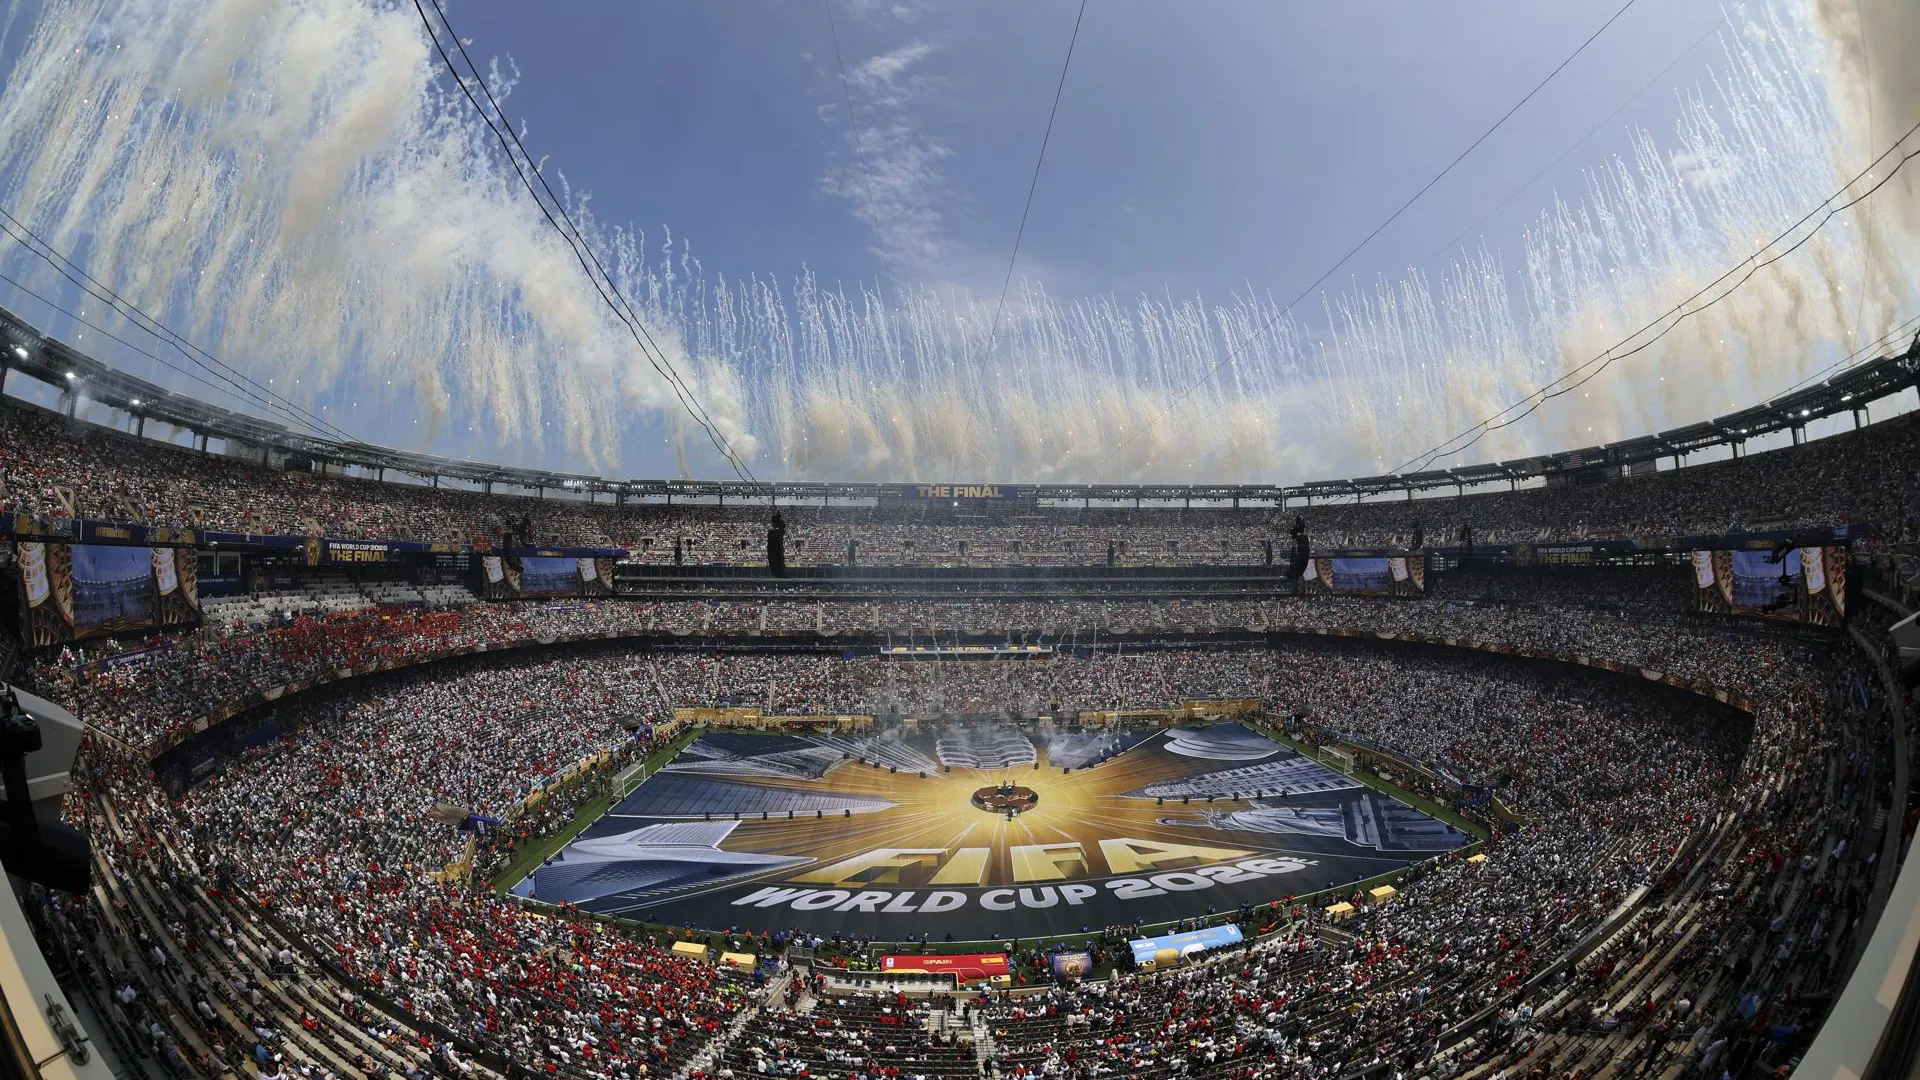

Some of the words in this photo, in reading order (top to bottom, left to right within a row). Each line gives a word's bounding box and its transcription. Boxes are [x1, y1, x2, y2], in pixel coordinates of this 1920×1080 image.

[917, 486, 950, 498] THE
[953, 486, 1004, 498] FINAL
[330, 550, 353, 561] THE
[354, 551, 387, 561] FINAL
[1561, 553, 1592, 563] FINAL
[783, 838, 1257, 887] FIFA
[730, 886, 968, 912] WORLD
[979, 885, 1097, 911] CUP
[1104, 858, 1306, 900] 2026
